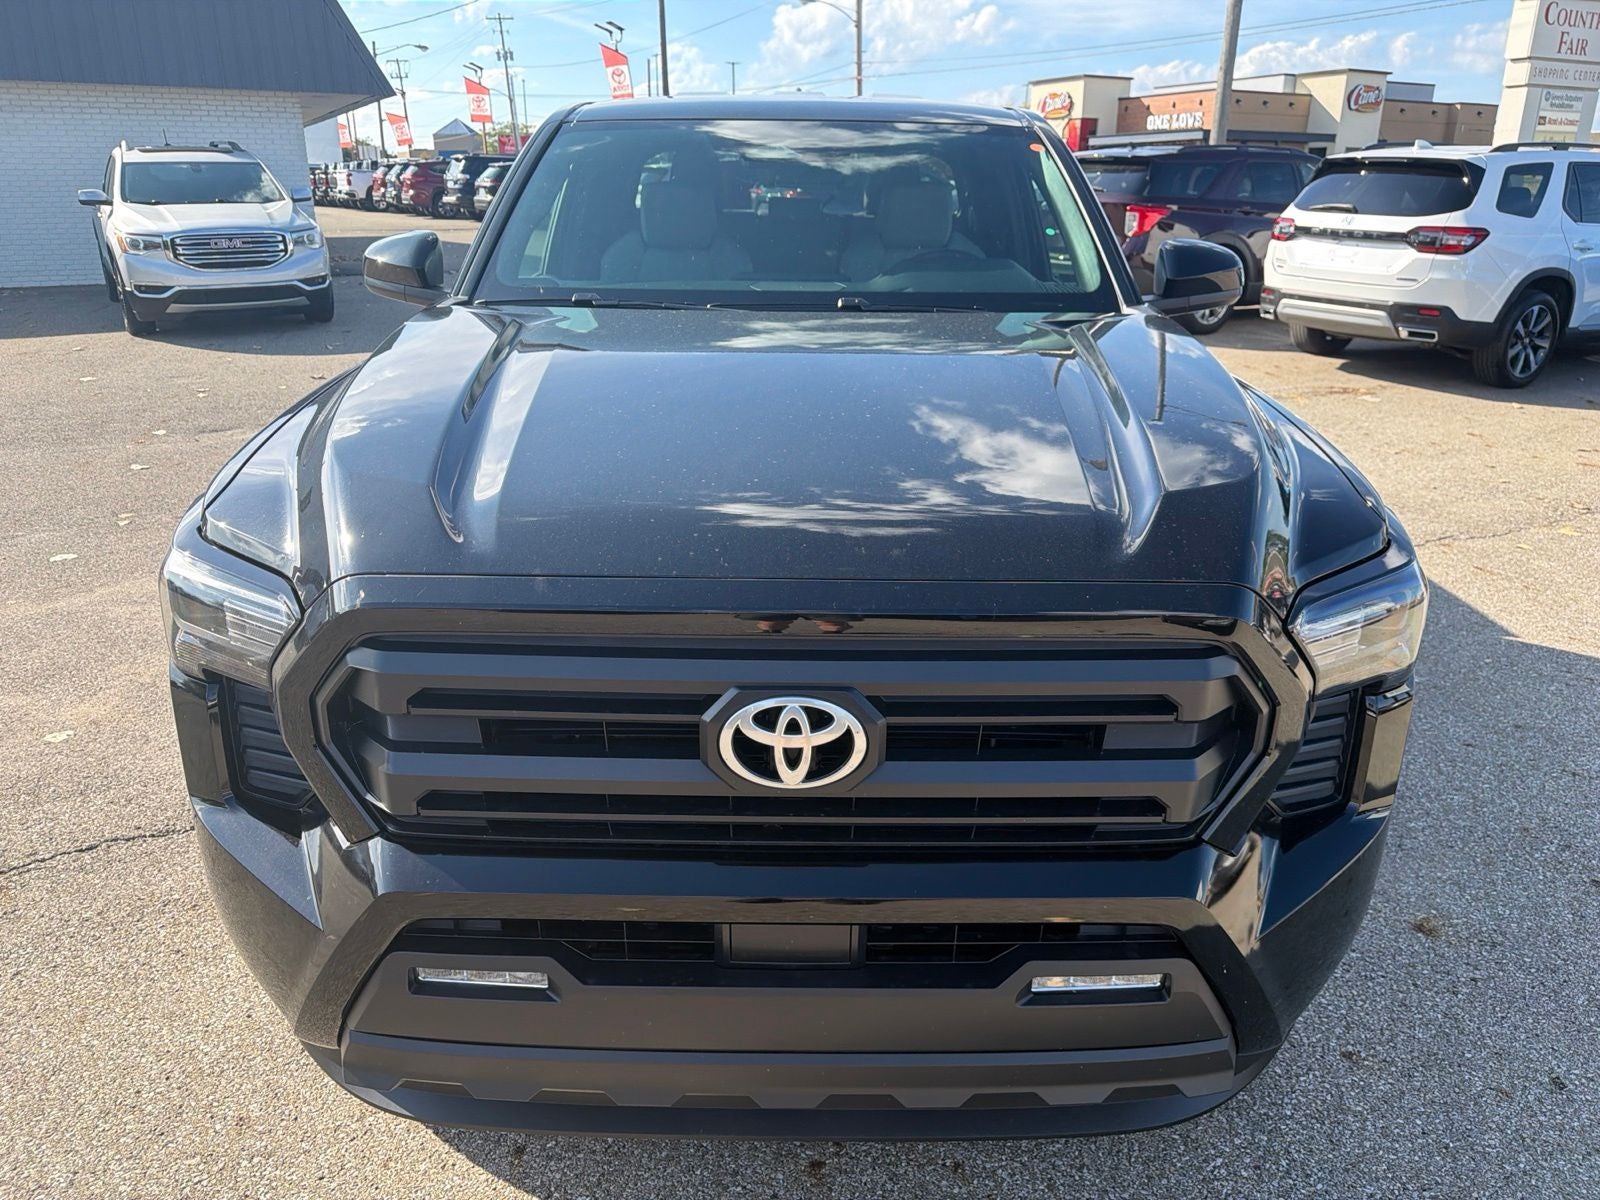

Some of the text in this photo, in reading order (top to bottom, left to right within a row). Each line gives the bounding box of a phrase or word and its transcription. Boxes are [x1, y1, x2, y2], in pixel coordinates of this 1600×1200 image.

[1557, 31, 1588, 56] FAIR
[1533, 66, 1569, 80] SHOPPING
[1147, 114, 1170, 130] ONE
[210, 238, 253, 249] GMC
